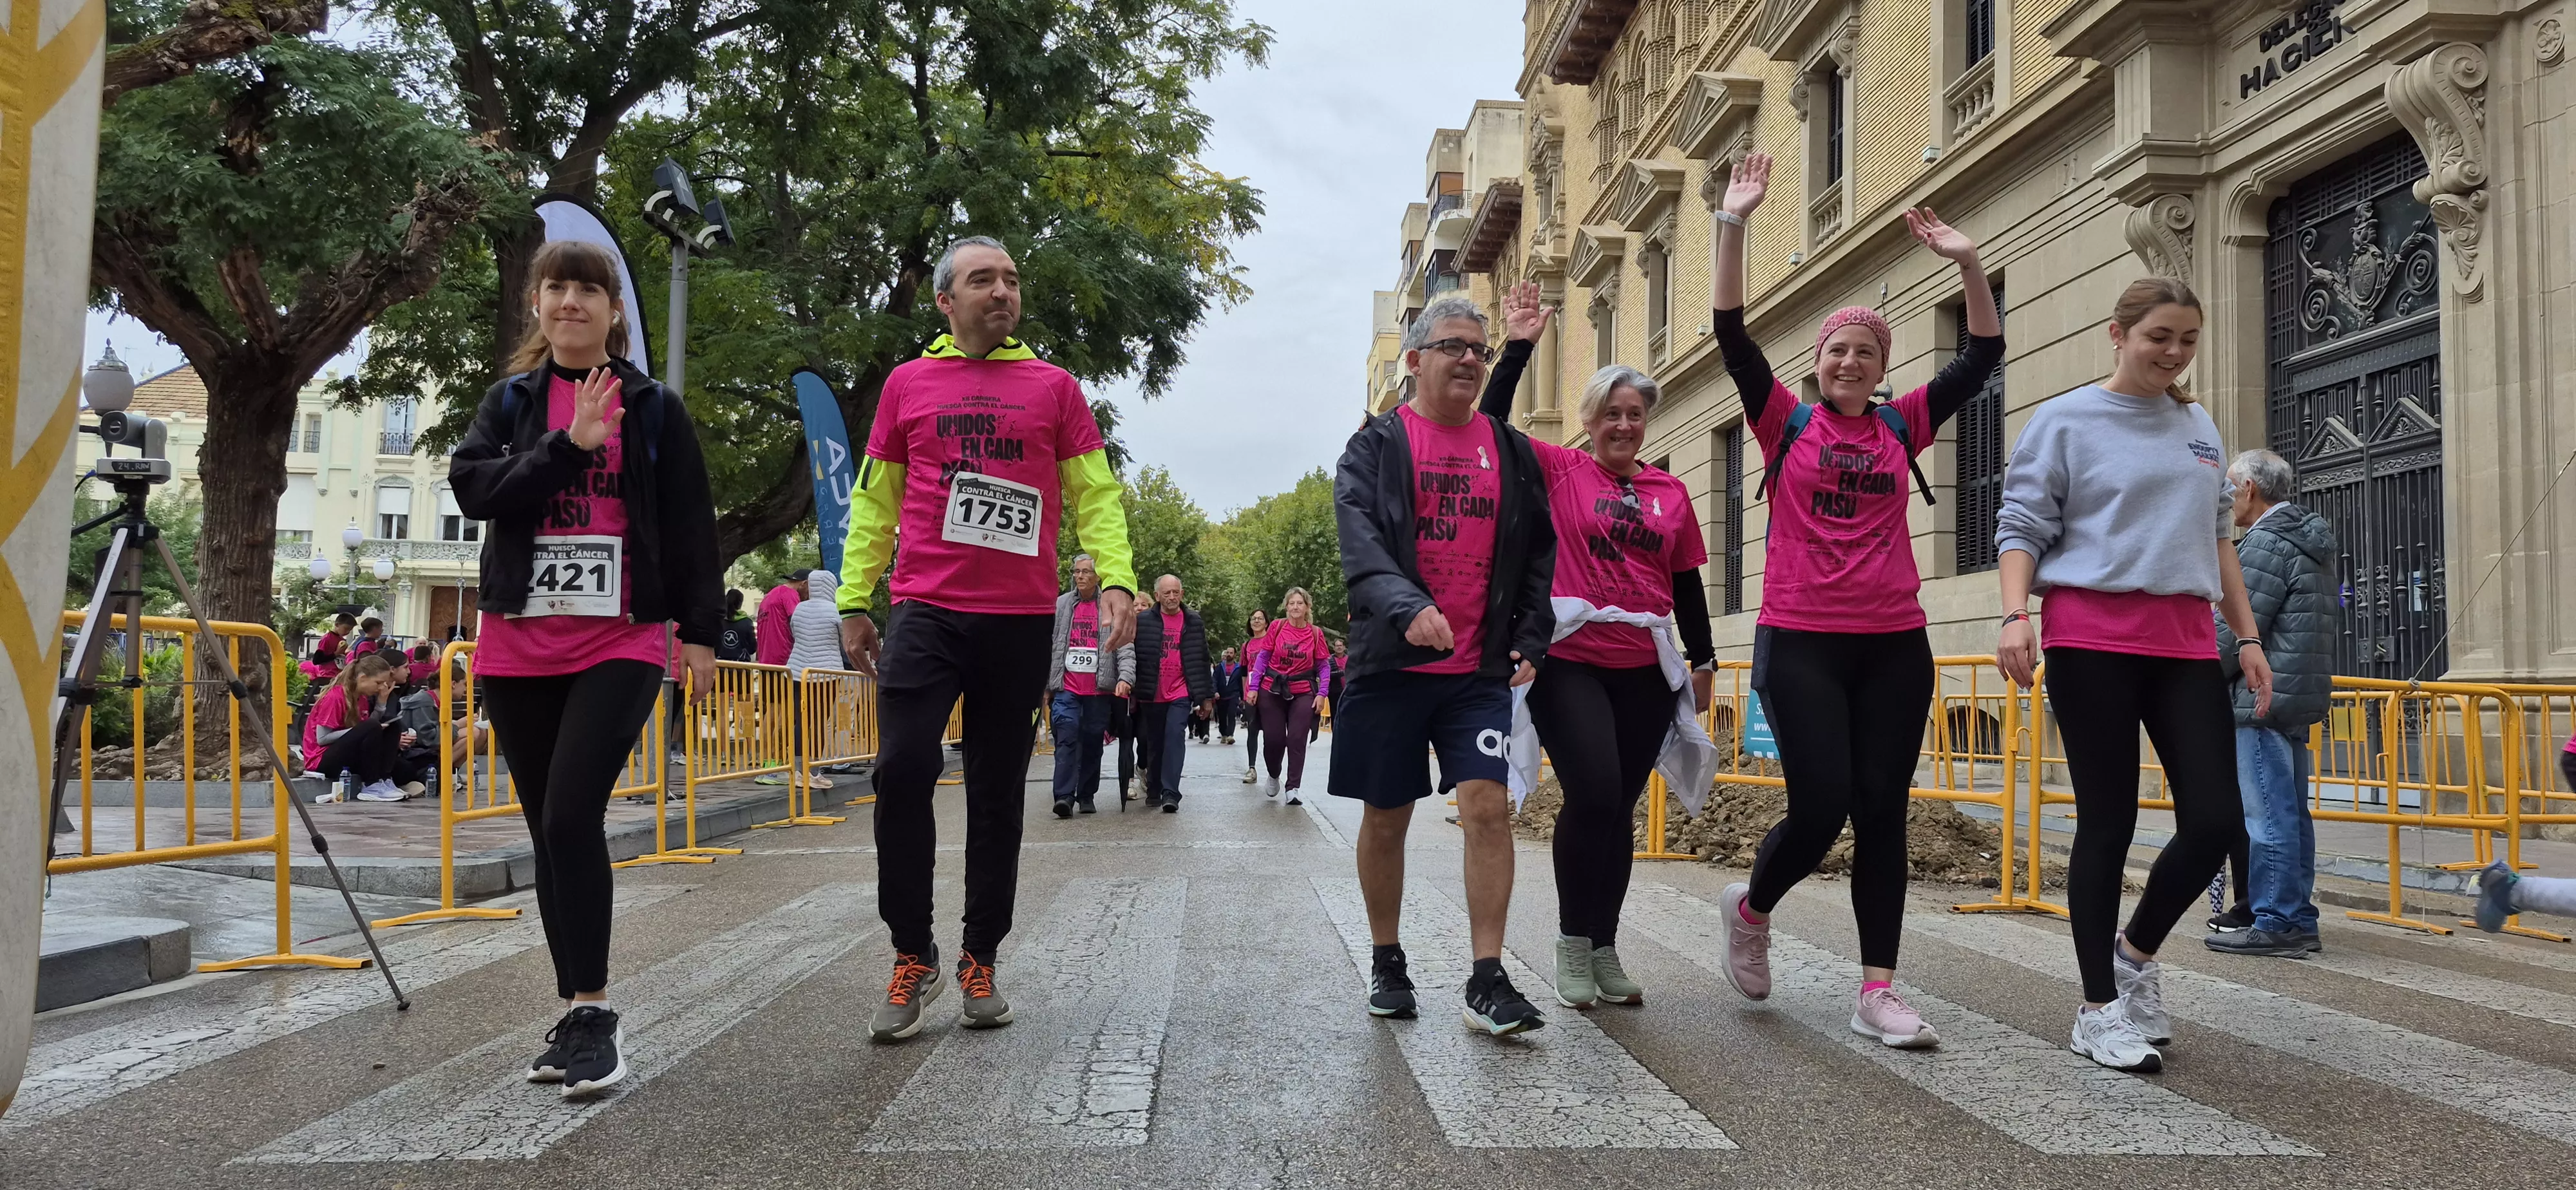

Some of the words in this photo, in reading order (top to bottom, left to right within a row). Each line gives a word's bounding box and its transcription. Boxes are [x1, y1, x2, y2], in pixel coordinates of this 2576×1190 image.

[936, 413, 996, 438] UNIDOS
[961, 437, 981, 458] EN
[984, 437, 1023, 462] CADA
[1818, 446, 1875, 472] UNIDOS
[989, 484, 1011, 494] HUESCA
[1420, 471, 1470, 495] UNIDOS
[1838, 471, 1860, 492] EN
[1860, 473, 1895, 495] CADA
[962, 486, 994, 498] CONTRA
[996, 491, 1004, 500] EL
[1006, 492, 1033, 507] CÁNCER
[1438, 495, 1457, 516] EN
[1459, 496, 1494, 520] CADA
[1811, 491, 1857, 519] PASO
[959, 497, 1032, 534] 1753
[1416, 516, 1457, 541] PASO
[1610, 520, 1629, 543] EN
[1630, 525, 1663, 553] CADA
[570, 549, 609, 560] CÁNCER
[1081, 630, 1087, 638] EN
[1072, 656, 1092, 665] 299
